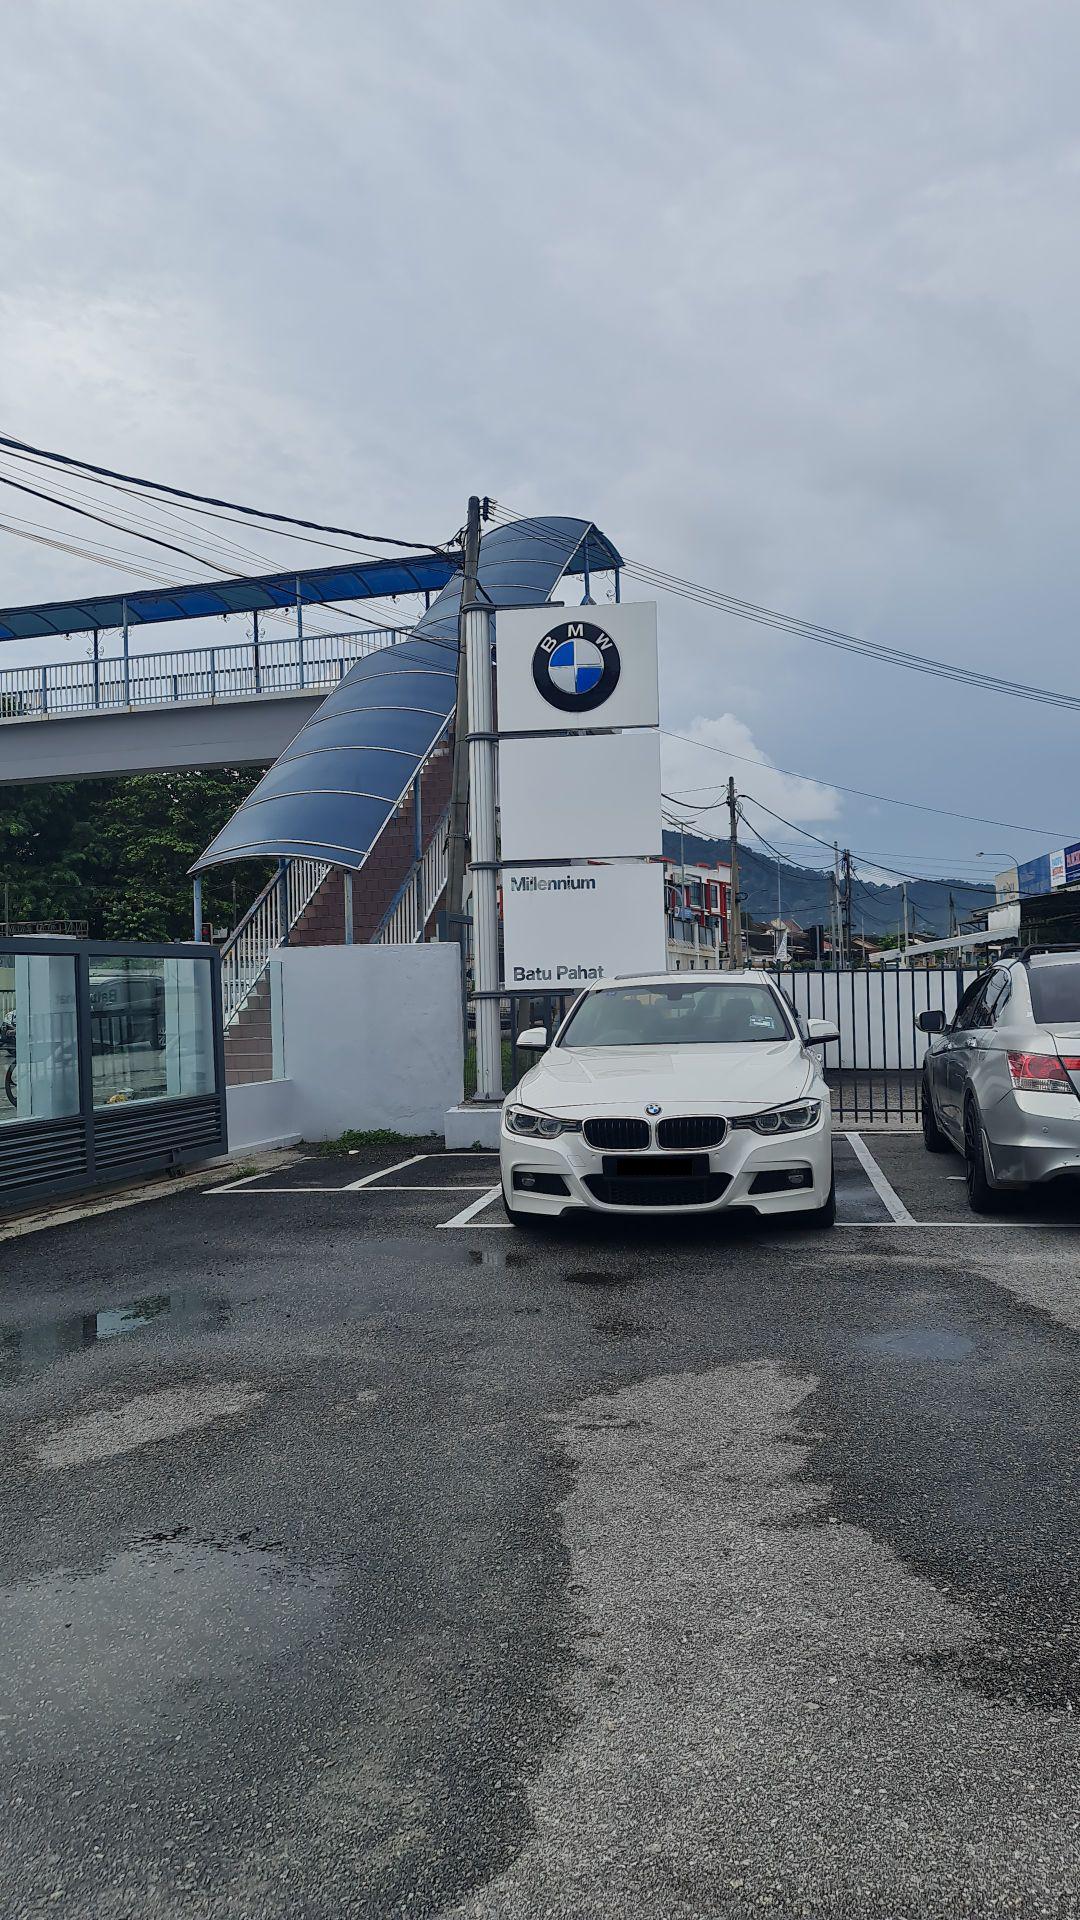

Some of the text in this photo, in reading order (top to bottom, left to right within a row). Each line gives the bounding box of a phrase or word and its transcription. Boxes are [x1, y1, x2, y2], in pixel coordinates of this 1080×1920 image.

[540, 623, 614, 654] BMW
[510, 875, 596, 892] Millennium
[513, 965, 604, 982] Batu Pahat
